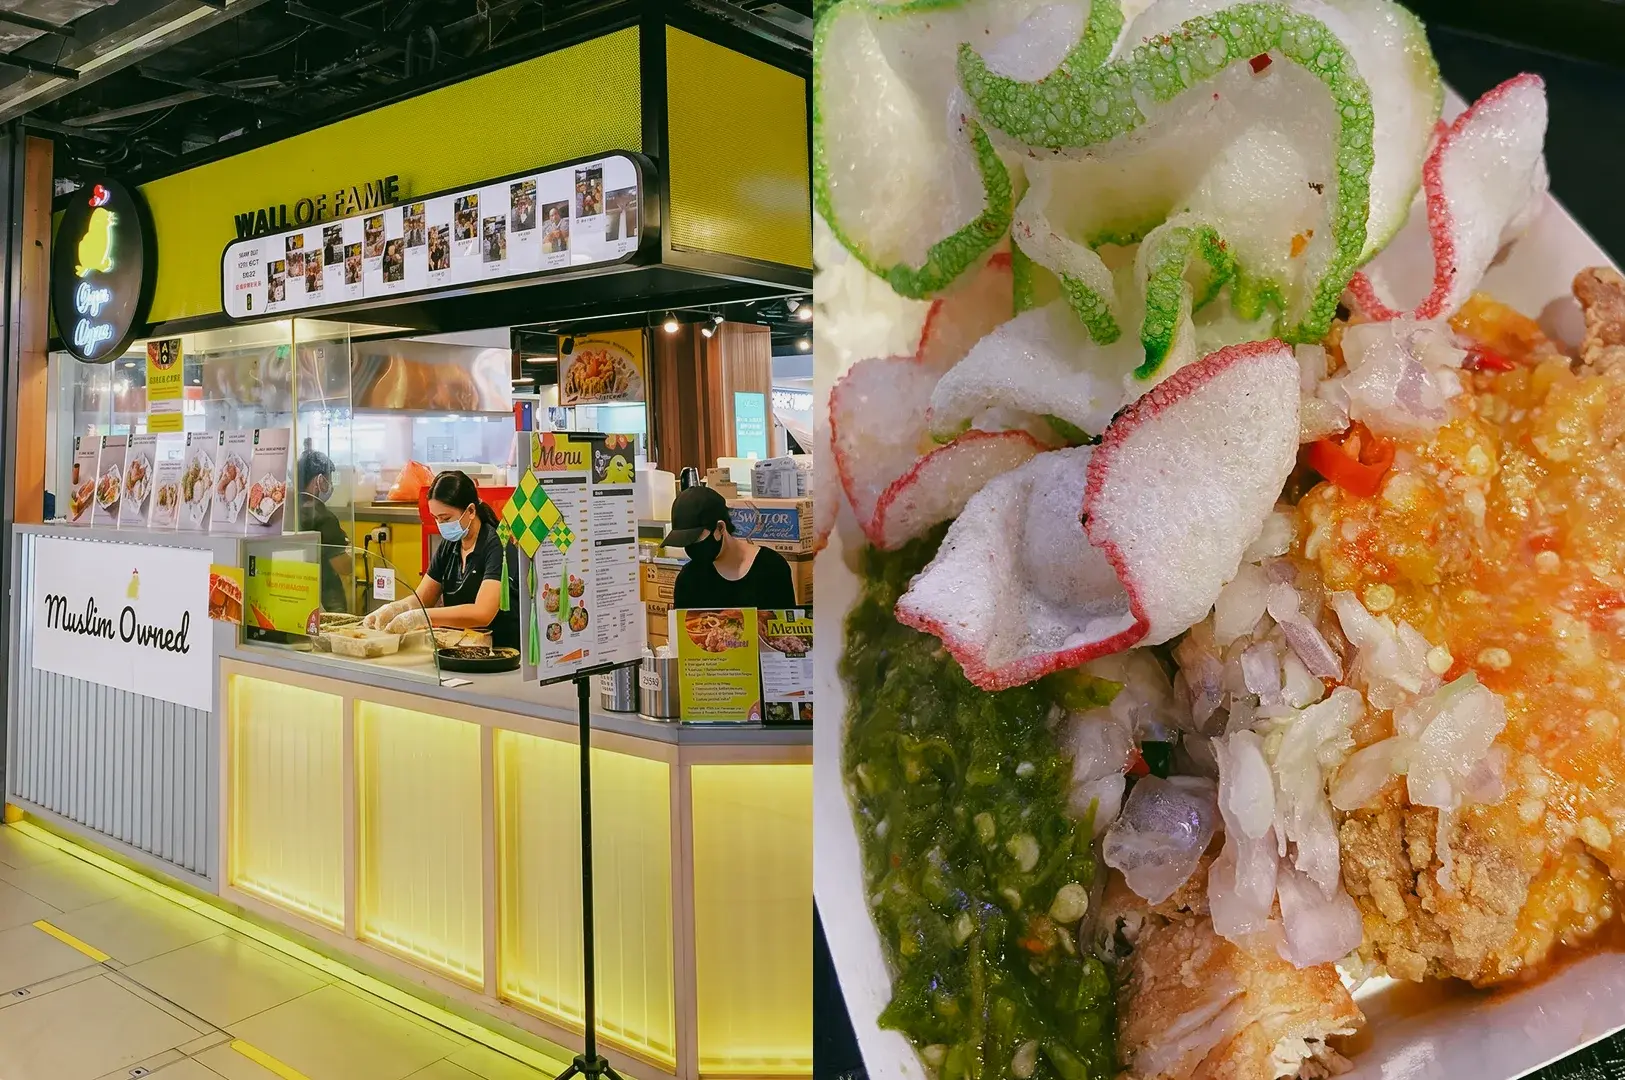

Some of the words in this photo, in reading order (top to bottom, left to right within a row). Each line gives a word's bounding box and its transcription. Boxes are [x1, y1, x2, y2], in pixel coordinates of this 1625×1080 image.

[234, 204, 291, 238] WALL
[294, 194, 326, 225] OF
[334, 175, 399, 217] FAME
[533, 446, 583, 469] Menu
[45, 593, 116, 640] Muslim
[119, 605, 190, 655] Owned
